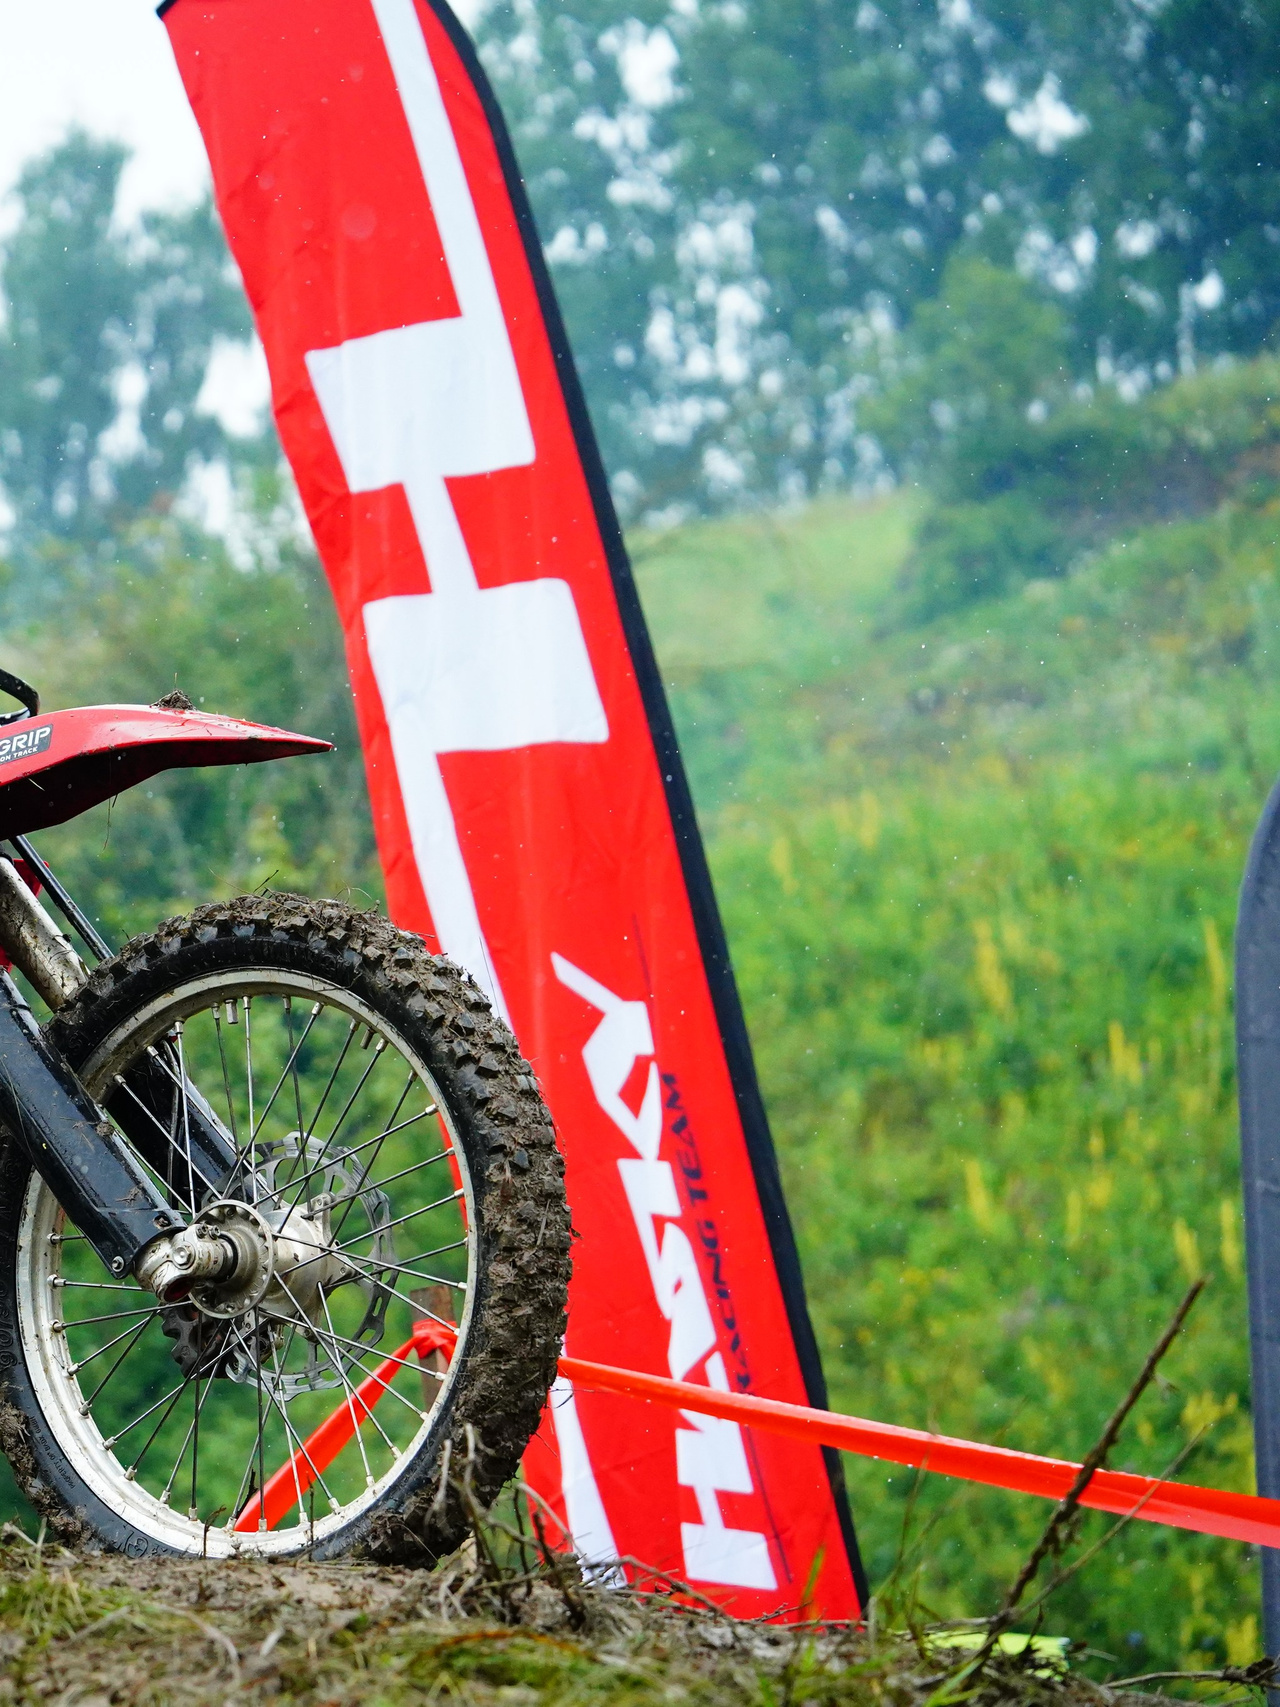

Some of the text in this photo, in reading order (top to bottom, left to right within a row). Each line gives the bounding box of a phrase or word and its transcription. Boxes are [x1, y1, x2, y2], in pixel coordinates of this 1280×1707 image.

[0, 754, 12, 763] ON
[13, 746, 38, 760] TRACK
[661, 1072, 707, 1204] TEAM
